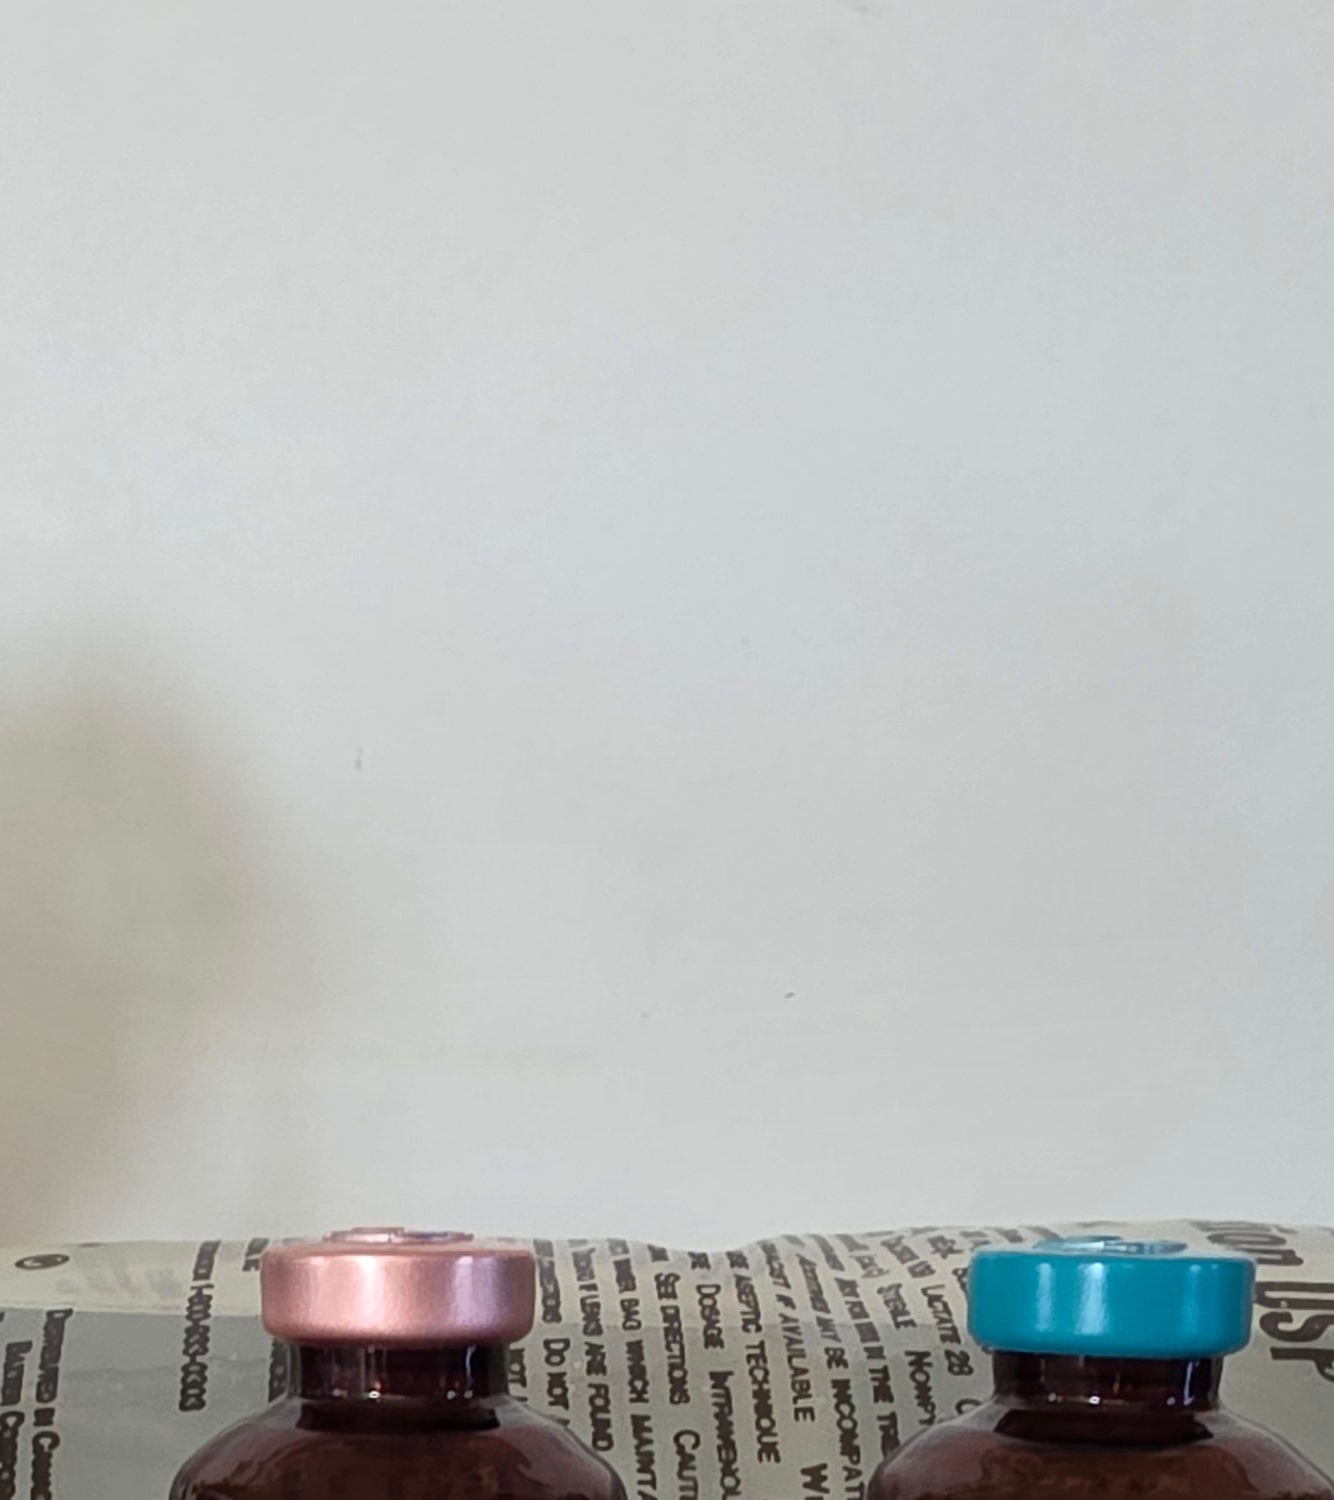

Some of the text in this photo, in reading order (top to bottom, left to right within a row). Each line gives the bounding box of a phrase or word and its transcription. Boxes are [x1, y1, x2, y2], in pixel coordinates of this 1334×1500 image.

[660, 1305, 691, 1405] DIRECTIONS
[745, 1339, 781, 1464] TECHNIQUE
[778, 1312, 816, 1422] AVAILABLE
[868, 1364, 895, 1403] THE
[588, 1382, 614, 1452] FOUND
